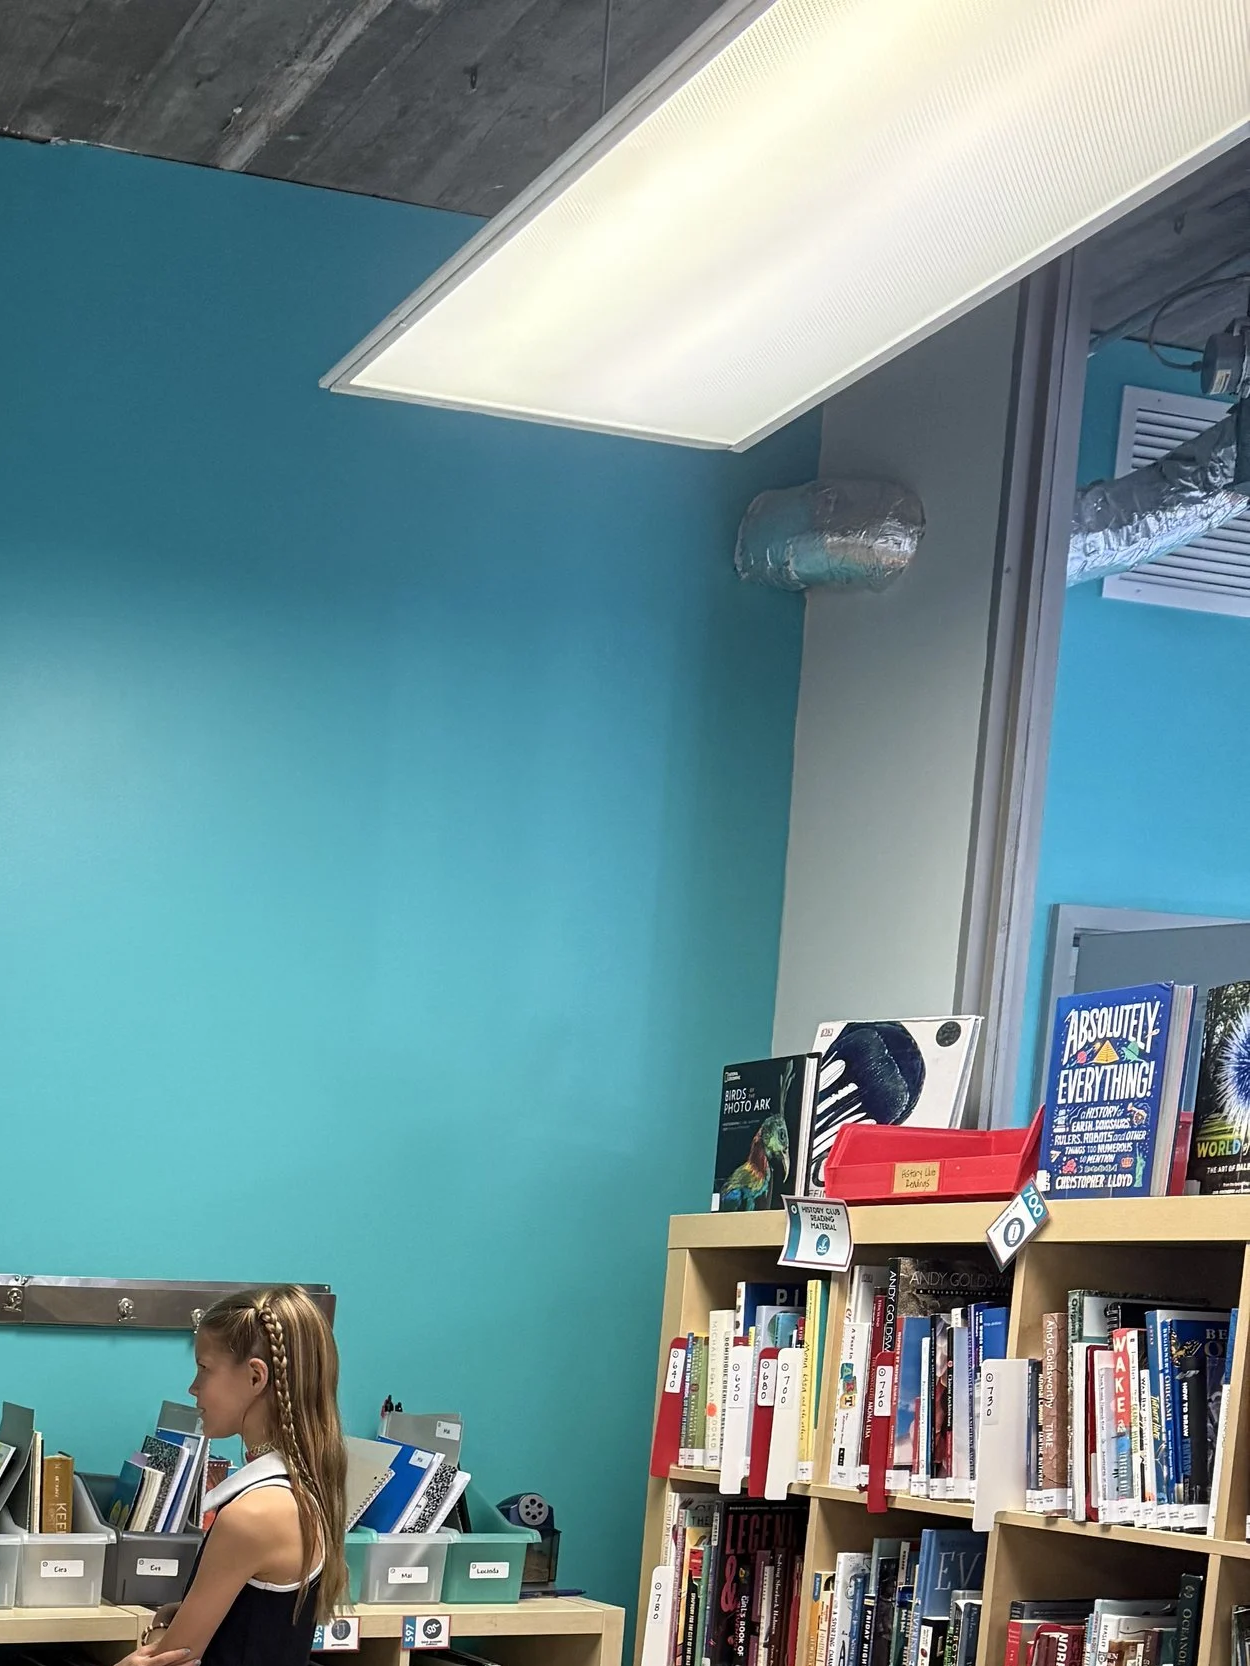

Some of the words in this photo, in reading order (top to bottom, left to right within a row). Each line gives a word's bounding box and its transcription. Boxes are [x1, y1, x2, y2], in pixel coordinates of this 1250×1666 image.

[1064, 1001, 1161, 1064] ABSOLUTELY
[725, 1088, 747, 1102] BIRDS
[1057, 1060, 1153, 1106] EVERYTHING!
[724, 1101, 752, 1114] PHOTO
[754, 1098, 771, 1111] ARK
[1086, 1106, 1118, 1119] HISTORY
[1065, 1146, 1086, 1155] THINGS
[1097, 1143, 1133, 1153] NUMEROUS
[1083, 1131, 1114, 1143] ROBOTS
[1126, 1130, 1147, 1140] OTHER
[1197, 1139, 1241, 1158] WORLD
[1086, 1154, 1116, 1163] MENTION
[1055, 1175, 1105, 1189] CHRISTOPHER
[1108, 1174, 1133, 1187] LLOYD
[801, 1206, 825, 1215] HISTORY
[826, 1207, 841, 1216] CLUB
[1024, 1185, 1044, 1218] 700
[810, 1214, 835, 1223] READING
[810, 1222, 837, 1231] MATERIAL
[888, 1270, 897, 1302] ANDY
[910, 1271, 946, 1286] ANDY
[1070, 1298, 1078, 1336] Origami
[1047, 1320, 1055, 1344] Andy
[733, 1373, 741, 1402] 650
[761, 1372, 769, 1400] 680
[780, 1375, 791, 1405] 700
[1045, 1347, 1055, 1409] Goldsworthy
[877, 1381, 886, 1408] 720
[986, 1386, 994, 1417] 730
[1165, 1374, 1173, 1421] ORIGAMI
[866, 1401, 874, 1424] MONA
[864, 1424, 872, 1439] LISA
[1046, 1423, 1054, 1448] TIME
[1182, 1438, 1192, 1476] FANTASY
[775, 1553, 783, 1578] Solving
[772, 1580, 782, 1608] Sherlock
[653, 1594, 662, 1620] 780
[405, 1624, 415, 1642] 597
[738, 1620, 747, 1644] BOOK
[771, 1609, 779, 1635] Holmes
[829, 1616, 838, 1648] SPORTING
[864, 1610, 872, 1640] FRIDAY
[910, 1611, 921, 1655] EVEREST
[1101, 1624, 1109, 1648] BEASLEY
[951, 1635, 960, 1666] BOYS
